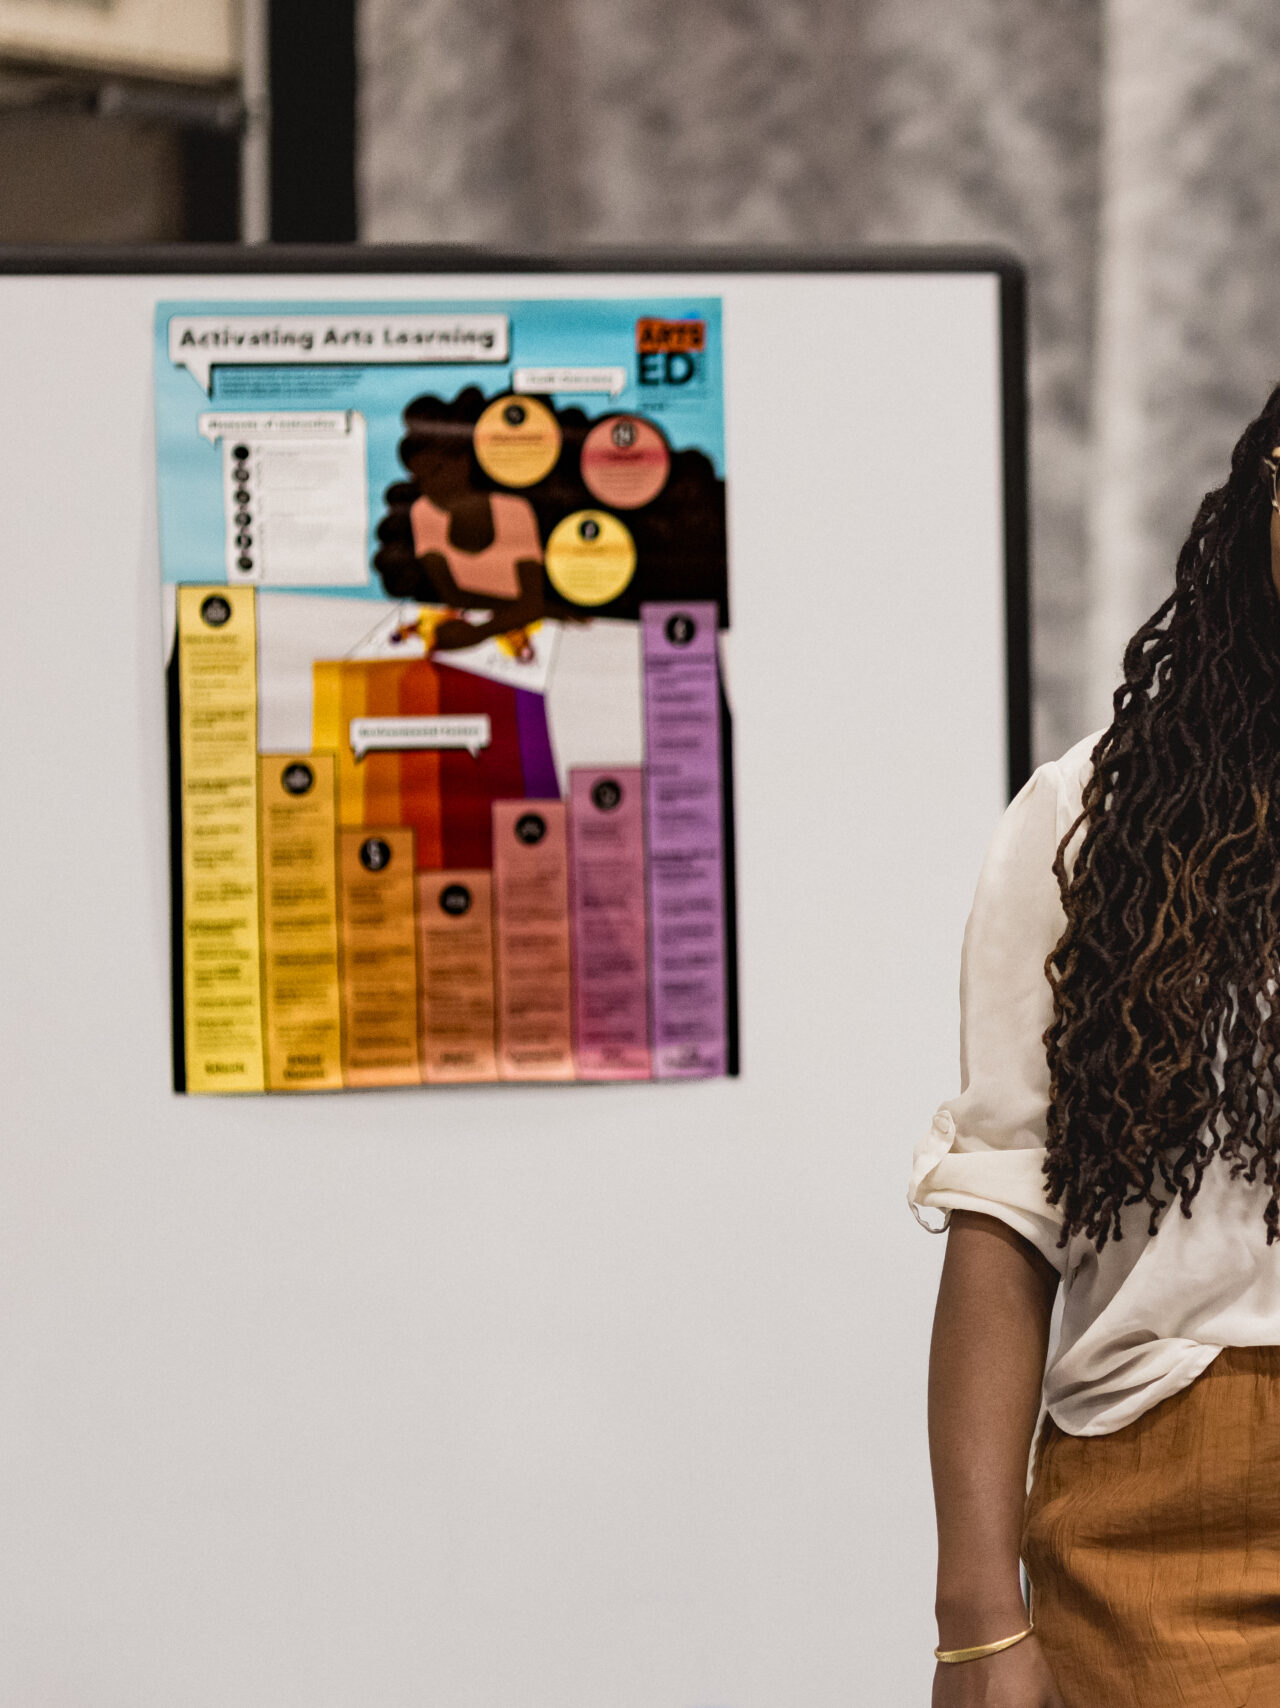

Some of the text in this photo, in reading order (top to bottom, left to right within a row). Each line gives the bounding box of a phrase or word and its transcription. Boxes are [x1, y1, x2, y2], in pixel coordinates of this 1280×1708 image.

[180, 325, 496, 351] Activating Arts Learning
[638, 322, 702, 345] ARTS
[637, 351, 695, 387] ED
